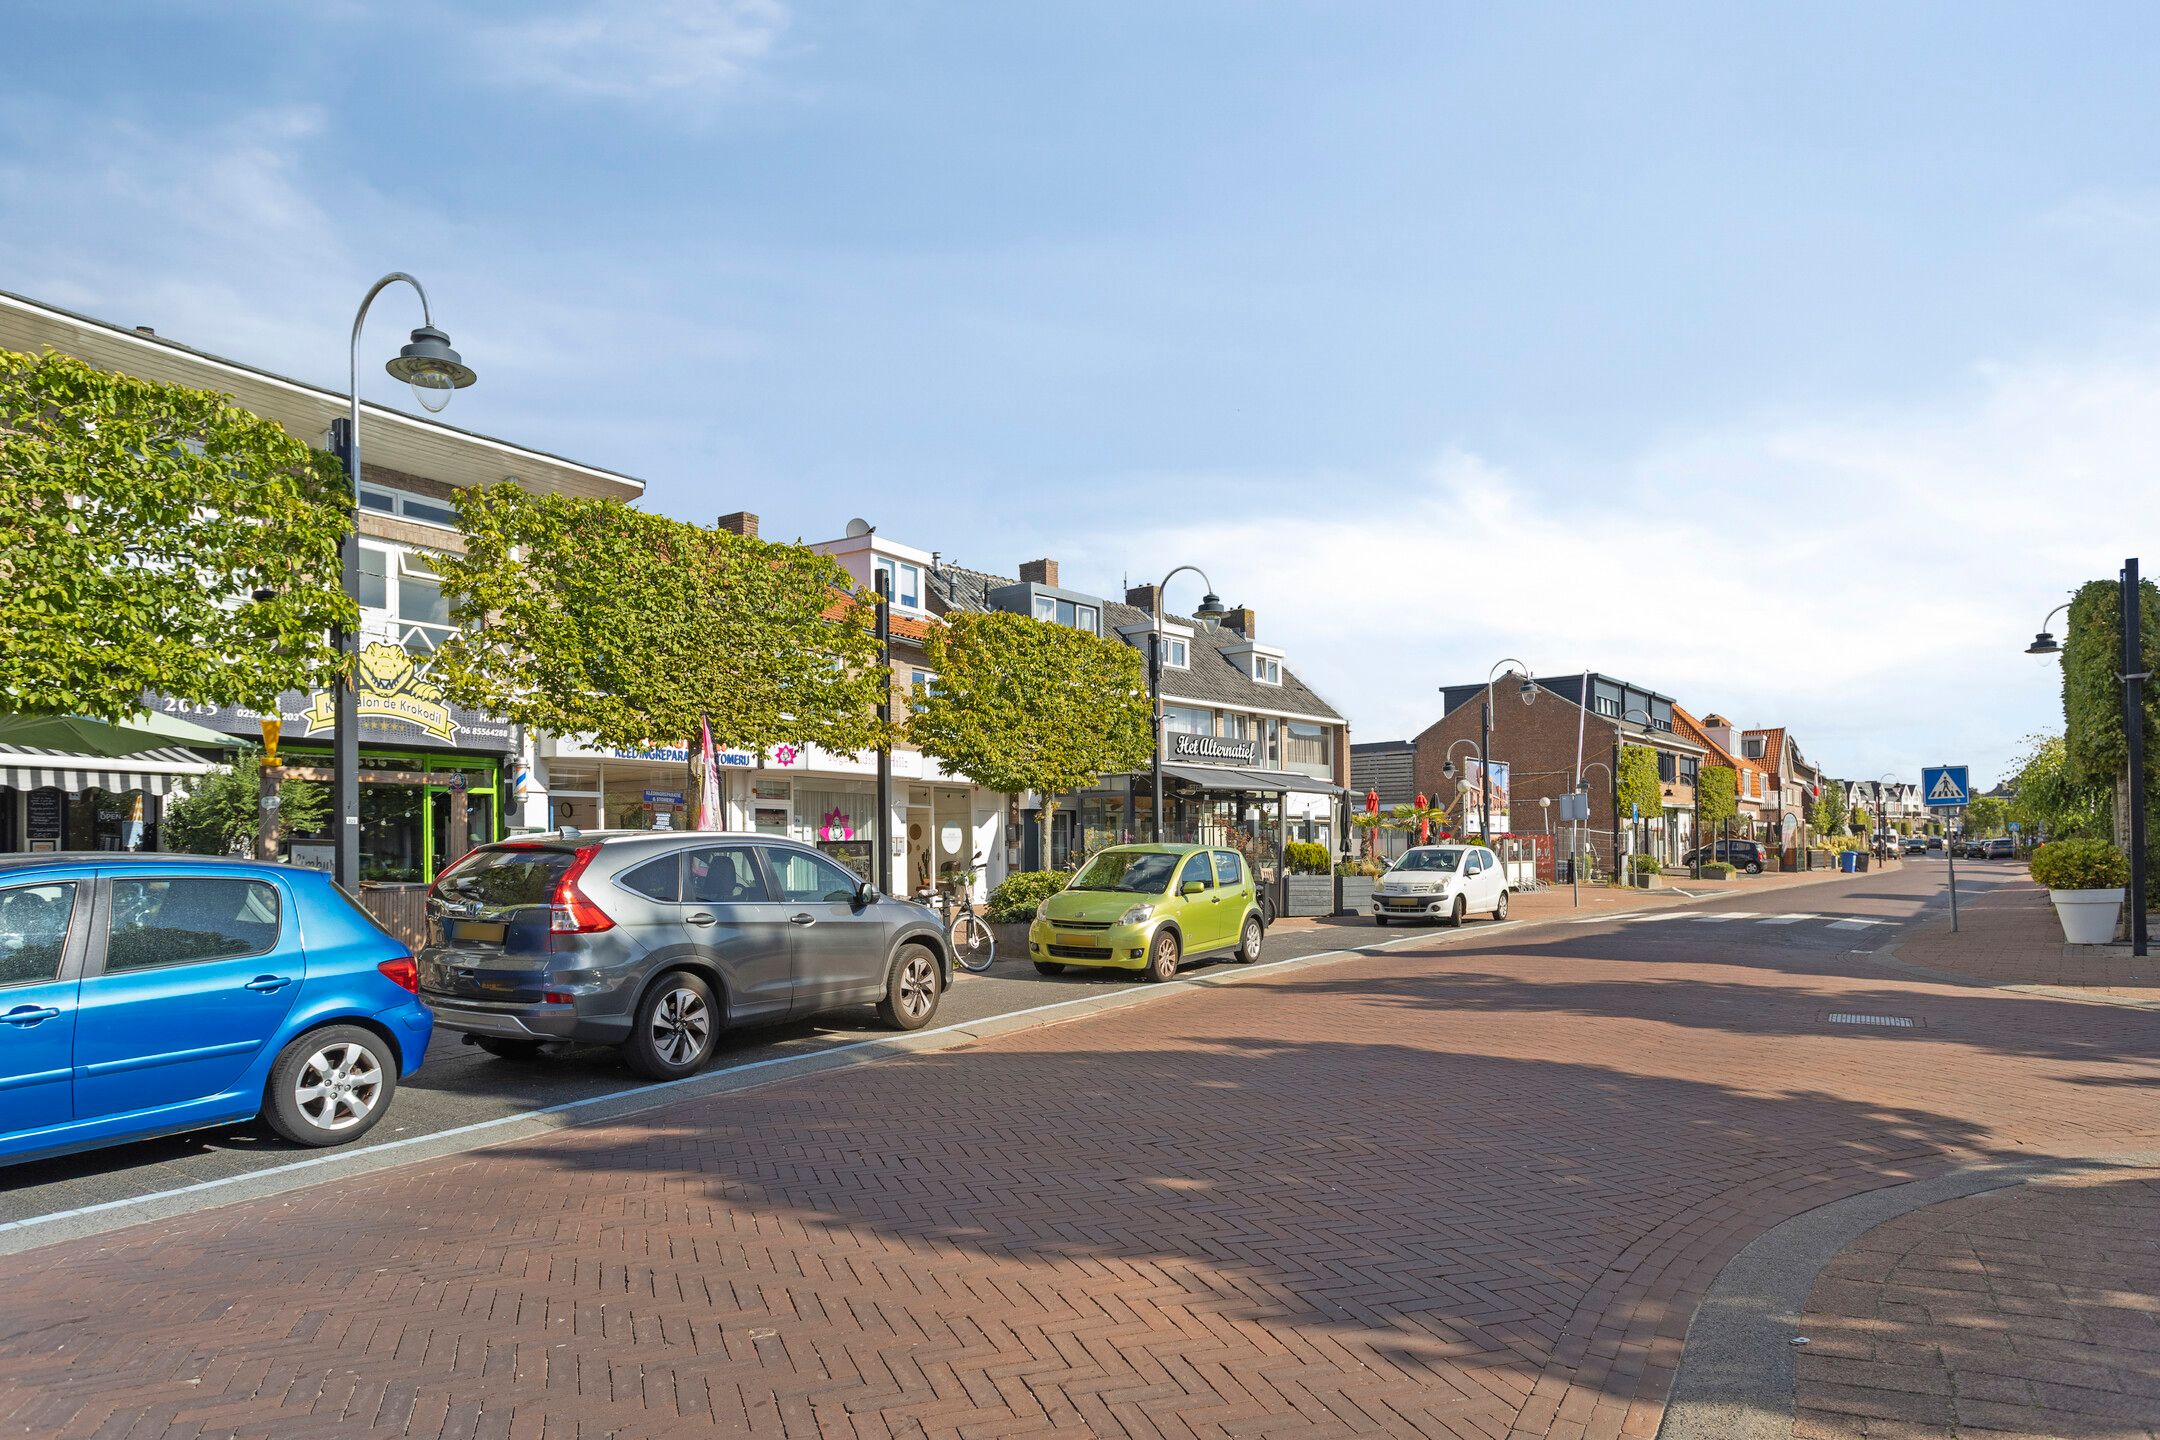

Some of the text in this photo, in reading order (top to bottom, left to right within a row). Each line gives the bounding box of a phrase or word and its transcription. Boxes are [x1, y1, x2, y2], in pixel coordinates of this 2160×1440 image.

[384, 696, 396, 709] de
[400, 700, 441, 724] Krokodil
[461, 727, 471, 735] 06
[615, 747, 750, 766] KLEDINGREPARA TOMERIJ
[1177, 735, 1256, 765] Het Alternatief
